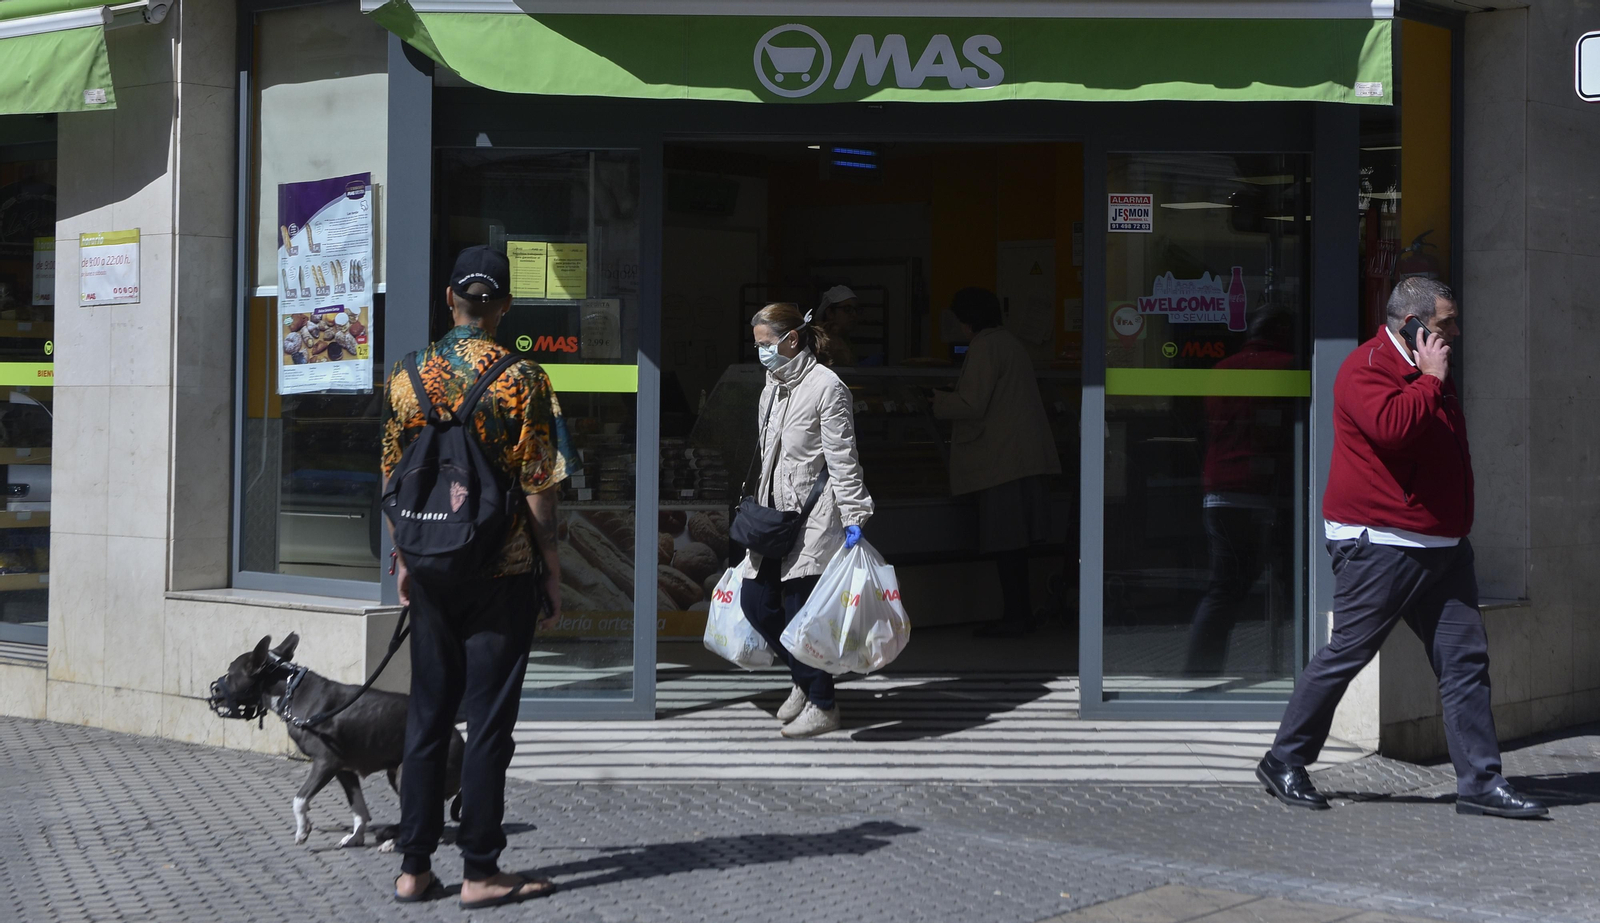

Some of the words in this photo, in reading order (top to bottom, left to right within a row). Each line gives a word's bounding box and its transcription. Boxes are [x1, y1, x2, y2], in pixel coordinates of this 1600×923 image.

[833, 34, 1005, 90] MAS
[1112, 208, 1149, 221] JESMON
[81, 234, 104, 246] horario
[36, 261, 43, 270] de
[81, 258, 88, 268] de
[106, 255, 124, 266] 22:00
[124, 254, 131, 265] h.
[1139, 296, 1225, 312] WELCOME
[1183, 313, 1228, 322] SEVILLA
[533, 336, 578, 353] MAS
[587, 338, 604, 347] 2.99
[1181, 342, 1225, 358] MAS
